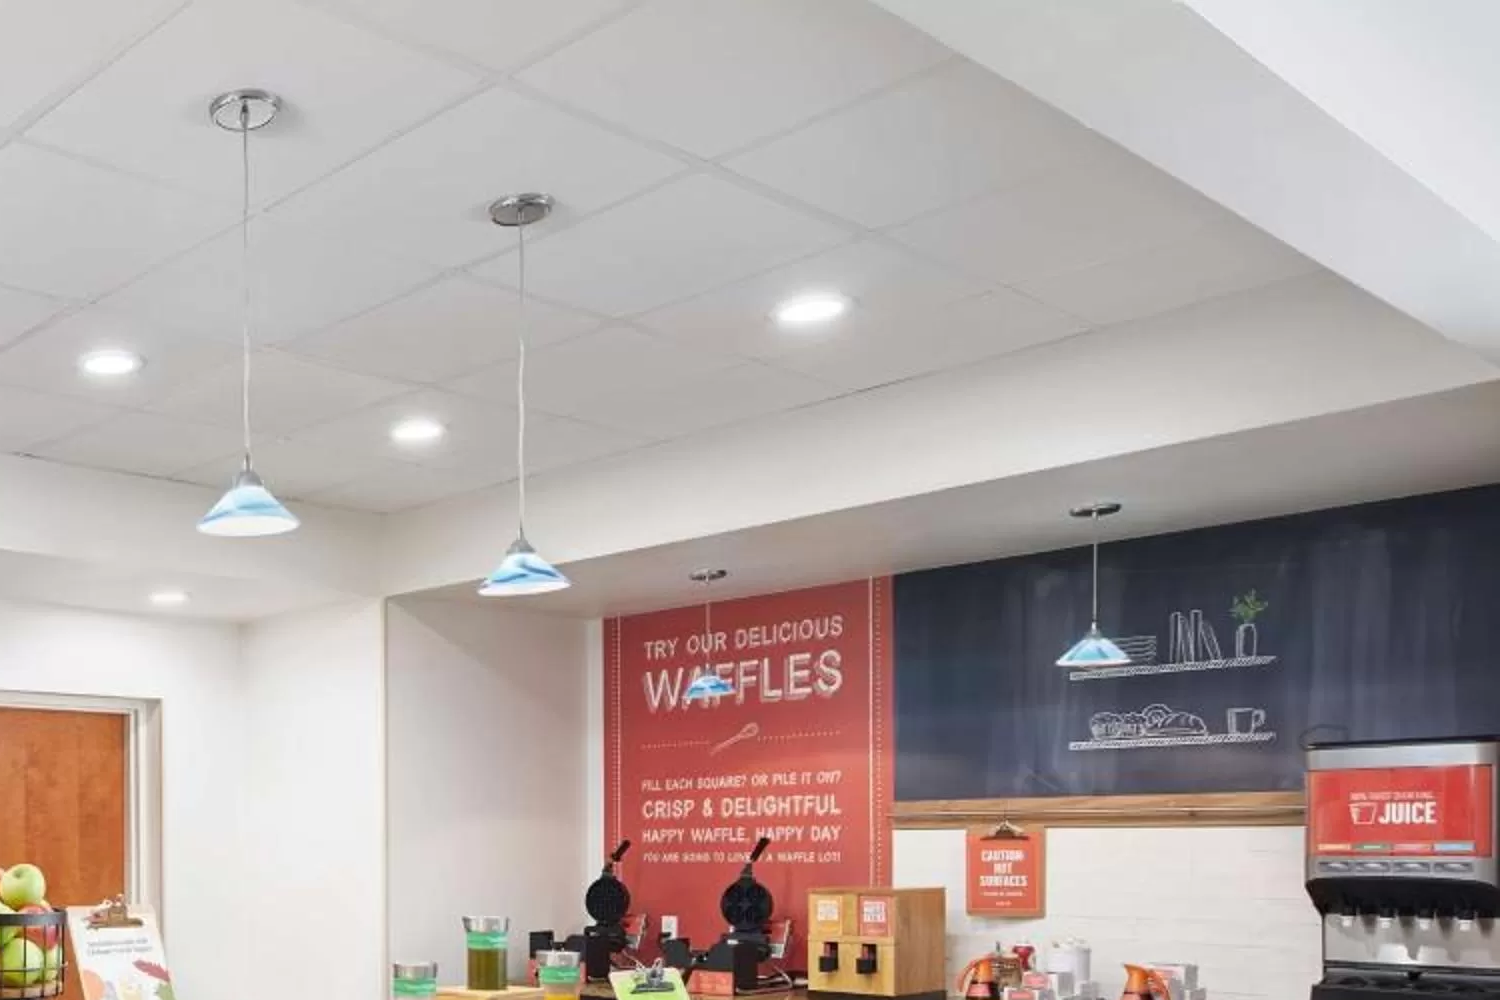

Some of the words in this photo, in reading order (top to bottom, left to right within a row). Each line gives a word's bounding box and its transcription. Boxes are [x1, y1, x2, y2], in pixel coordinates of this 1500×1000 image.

[644, 637, 679, 660] TRY
[686, 631, 728, 655] OUR
[735, 615, 844, 649] DELICIOUS
[642, 778, 662, 792] FILL
[665, 777, 693, 791] EACH
[697, 774, 746, 790] SQUARE?
[751, 773, 768, 786] OR
[772, 771, 797, 785] PILE
[801, 771, 812, 785] IT
[816, 768, 842, 785] ON?
[642, 798, 695, 819] CRISP
[702, 797, 713, 818] &
[721, 793, 842, 817] DELIGHTFUL
[1378, 801, 1438, 825] JUICE
[642, 827, 684, 844] HAPPY
[755, 825, 804, 843] HAPPY
[811, 824, 842, 842] DAY
[777, 851, 815, 863] WAFFLE
